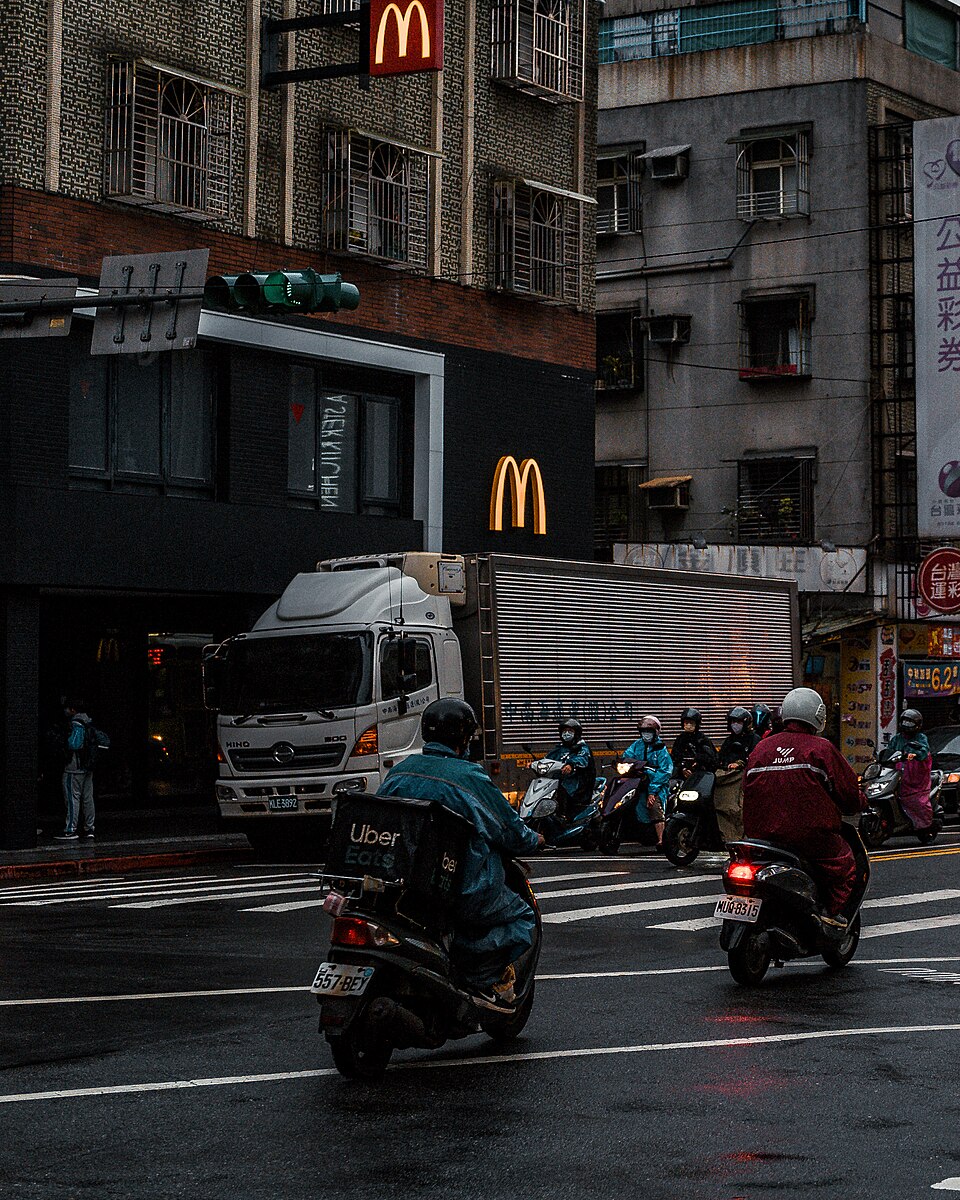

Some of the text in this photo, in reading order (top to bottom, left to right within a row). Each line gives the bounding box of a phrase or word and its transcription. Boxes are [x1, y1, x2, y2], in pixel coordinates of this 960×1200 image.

[226, 741, 250, 749] HINO
[773, 756, 795, 765] JUMP
[350, 823, 401, 847] Uber
[344, 843, 395, 869] Eats
[313, 973, 369, 992] 557-BEY
